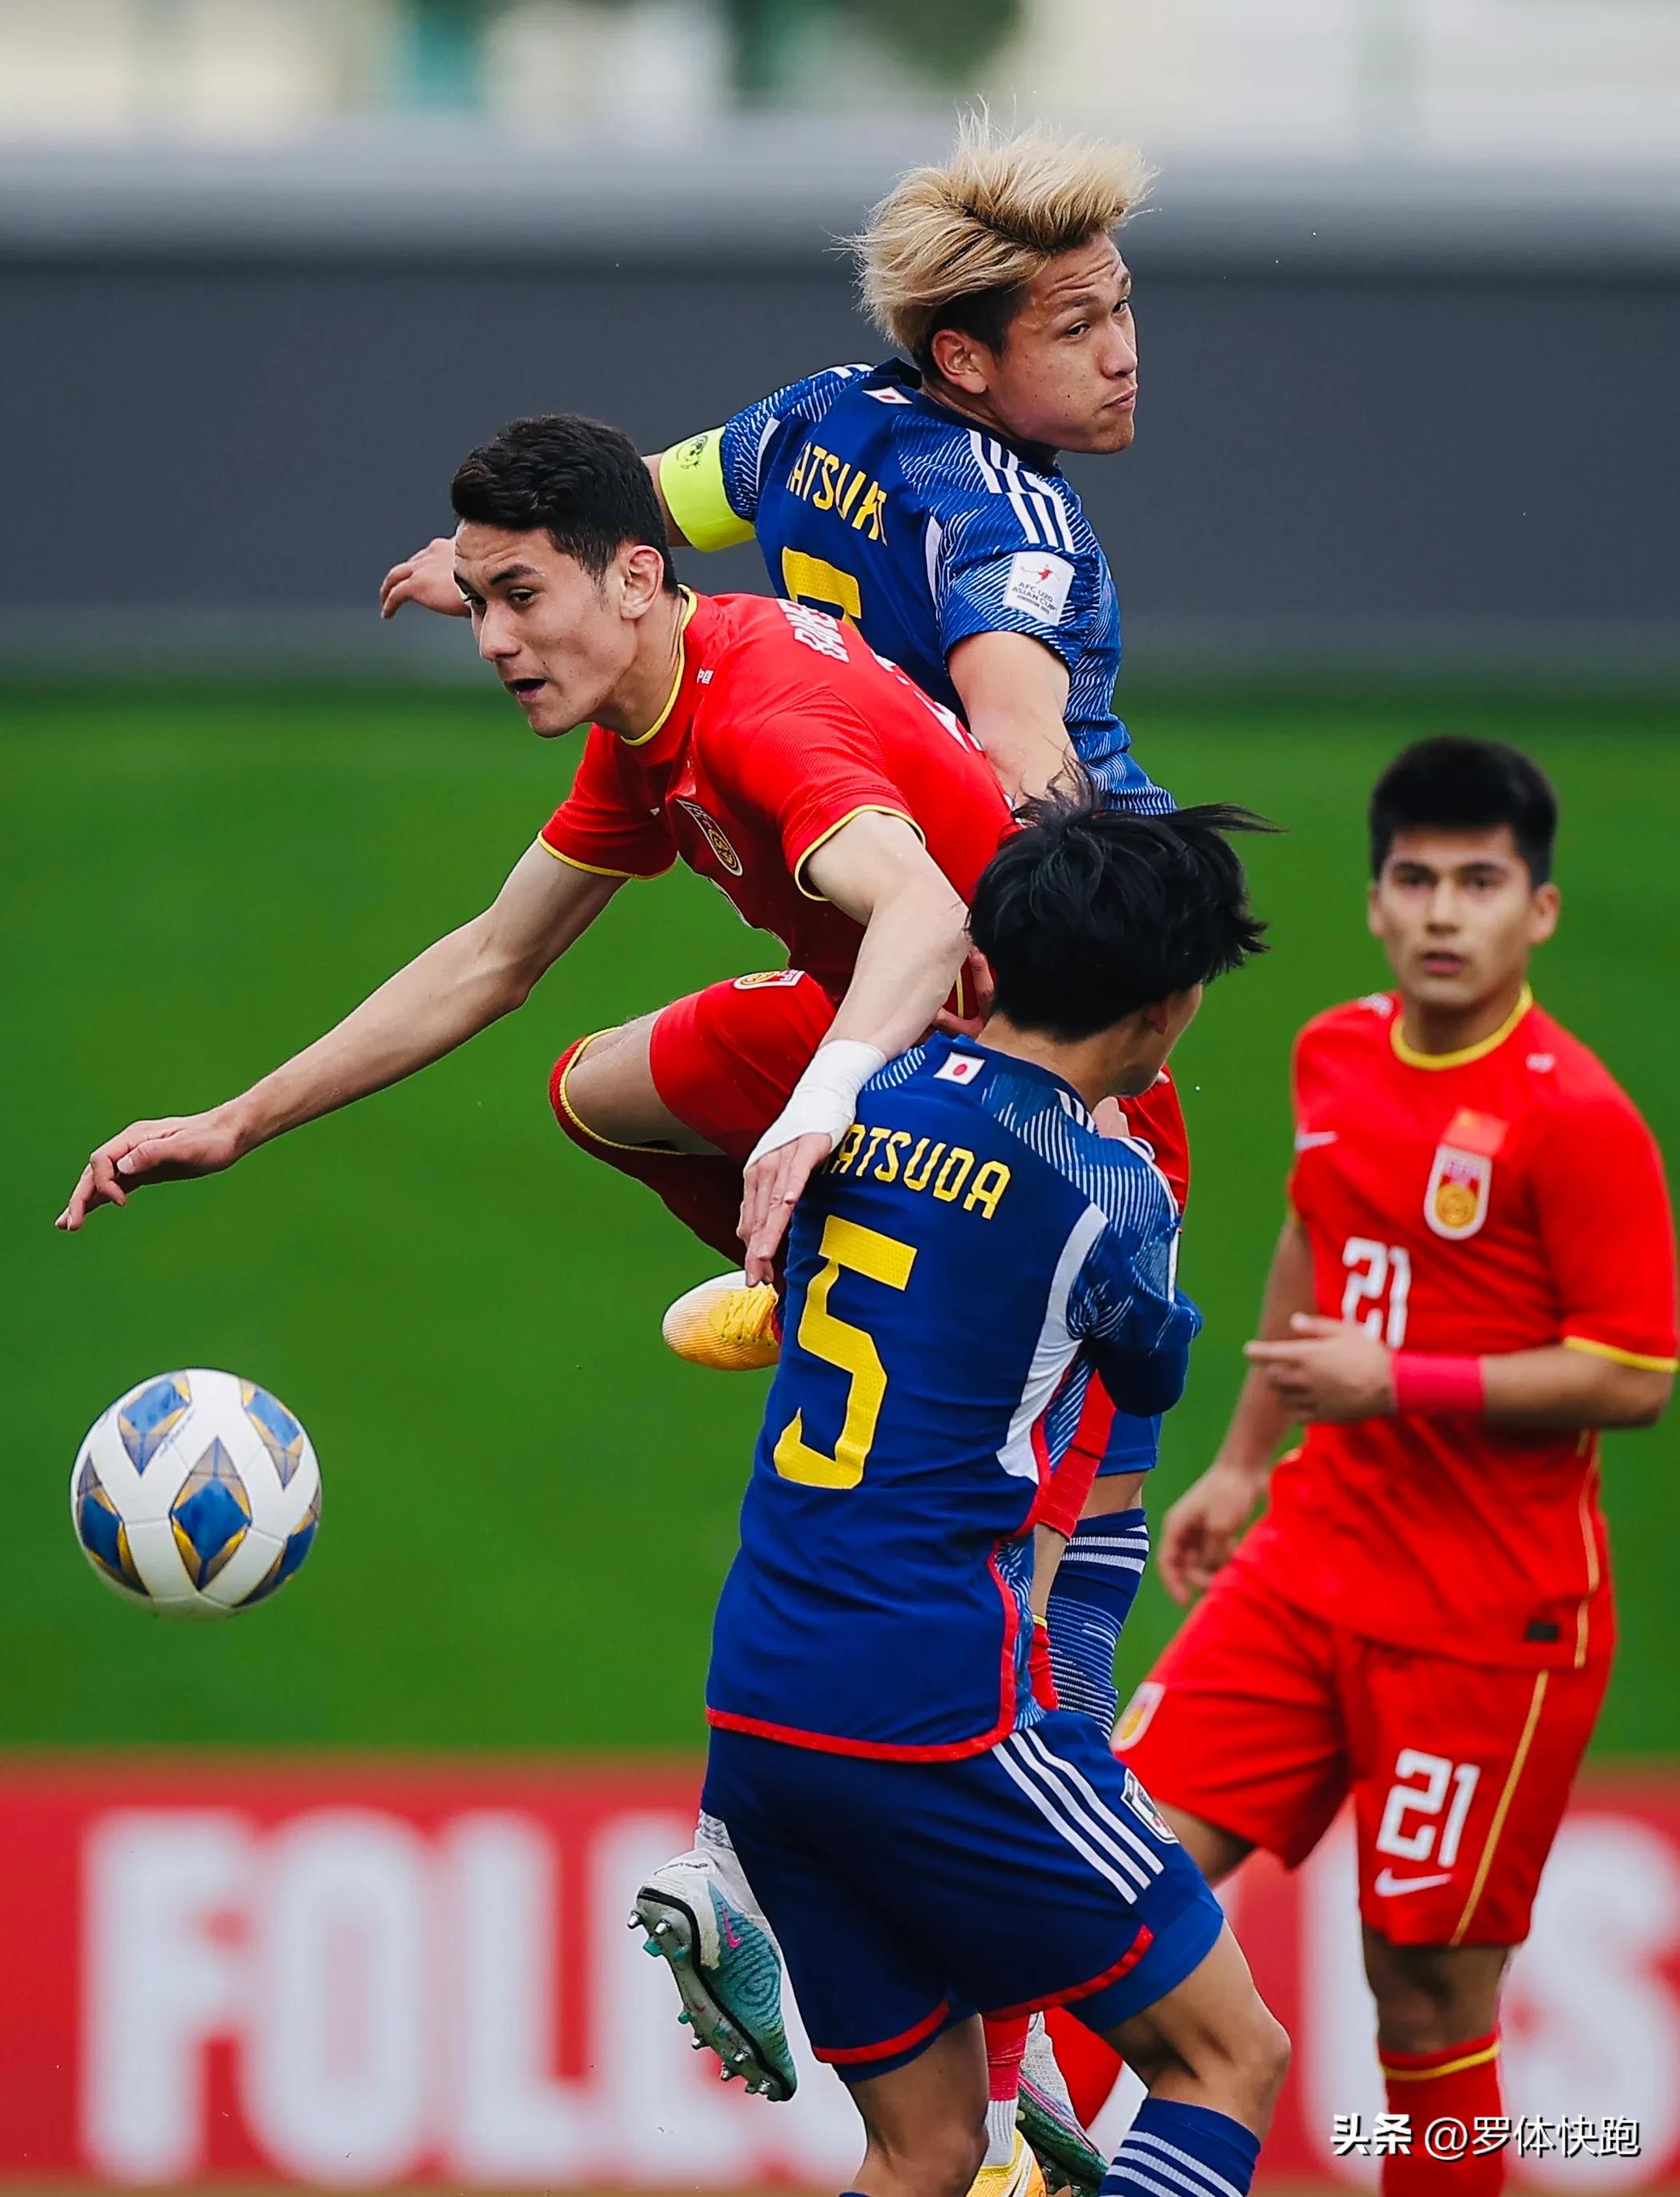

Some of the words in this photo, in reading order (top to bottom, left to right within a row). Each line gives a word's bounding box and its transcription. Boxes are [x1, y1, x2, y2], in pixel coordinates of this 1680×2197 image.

[1011, 586, 1039, 601] ASIAN
[828, 1122, 1011, 1220] ATSUDA
[1342, 1236, 1411, 1348] 21
[774, 1214, 918, 1490] 5
[1375, 1748, 1480, 1867] 21
[84, 1806, 871, 2186] FOLL
